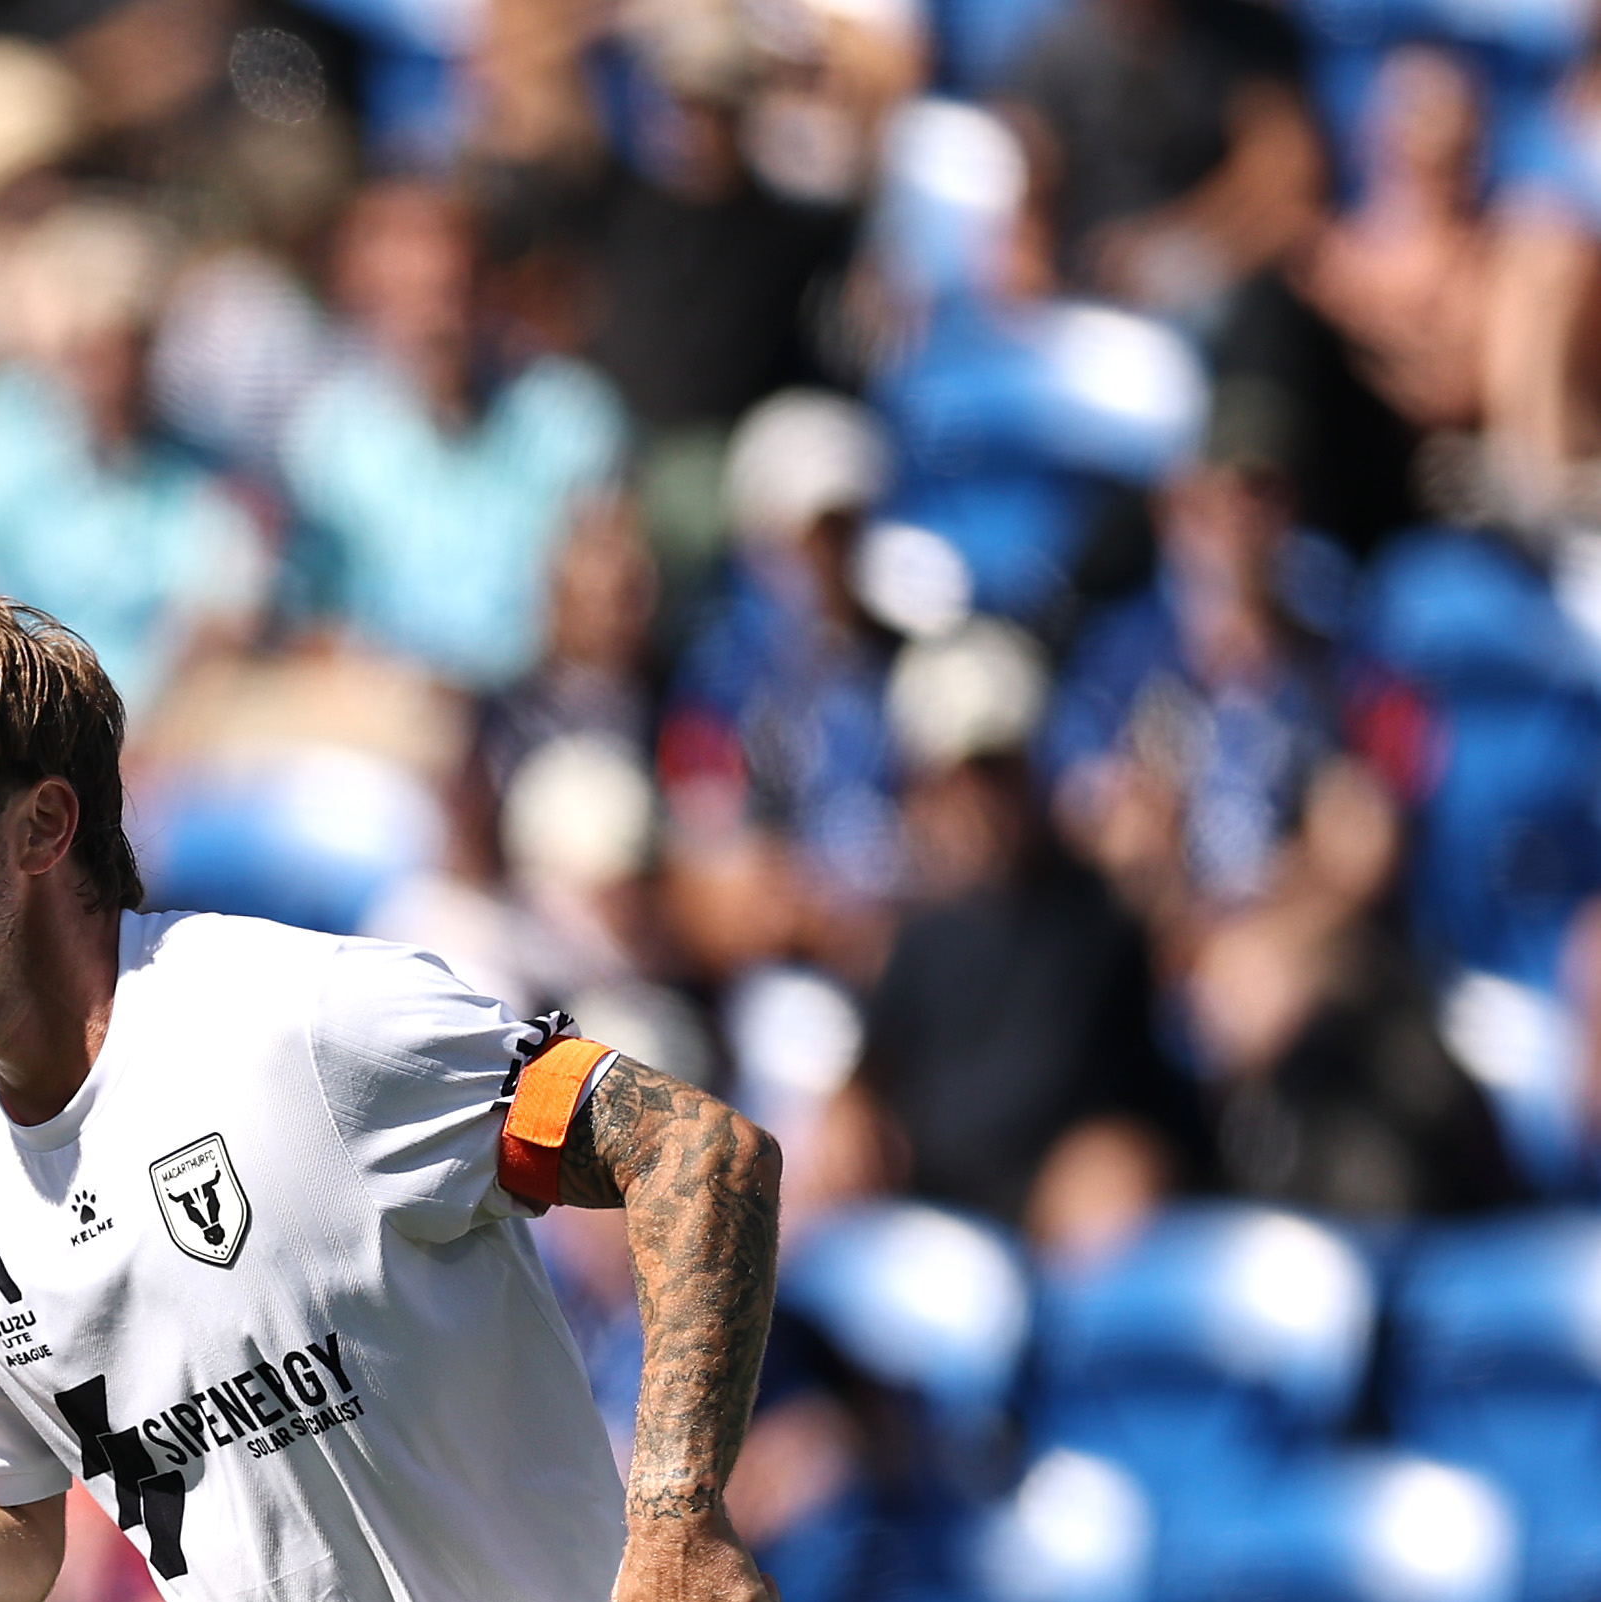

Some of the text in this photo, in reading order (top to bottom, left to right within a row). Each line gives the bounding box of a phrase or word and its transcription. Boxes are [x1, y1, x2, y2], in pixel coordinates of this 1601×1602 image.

[70, 1217, 115, 1247] KELME
[2, 1332, 33, 1349] UTE
[247, 1427, 296, 1459] SOLAR
